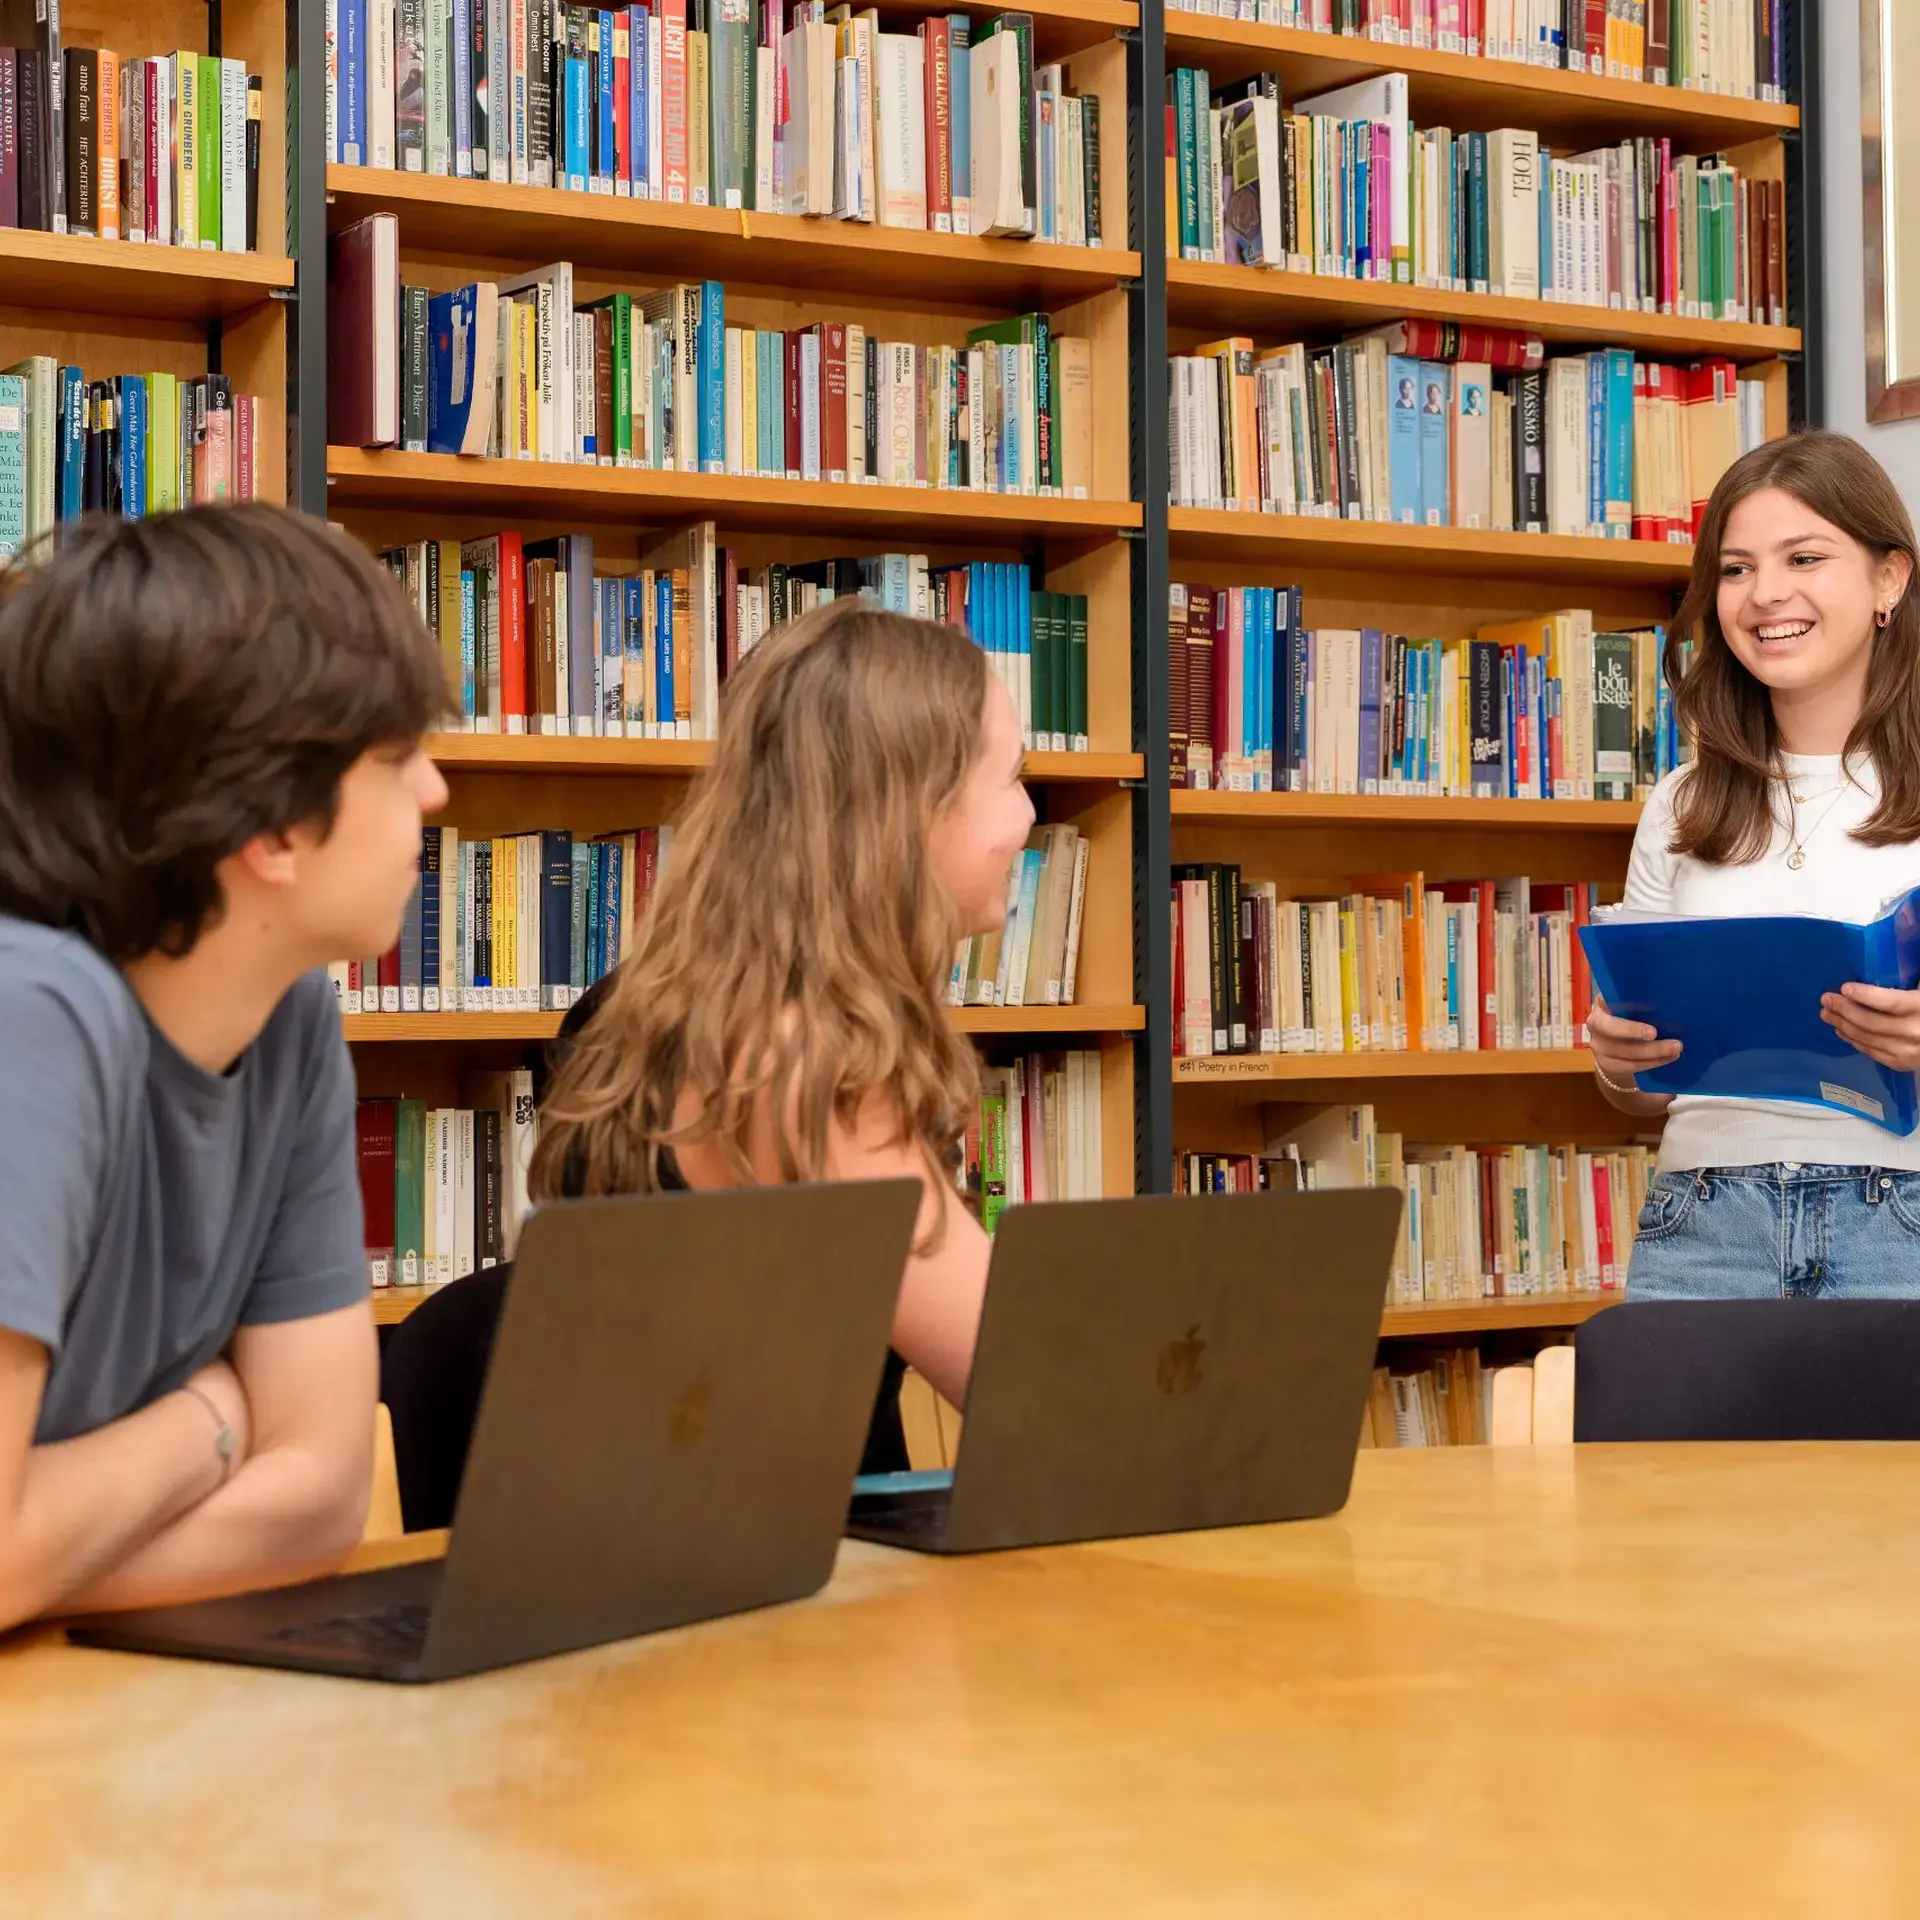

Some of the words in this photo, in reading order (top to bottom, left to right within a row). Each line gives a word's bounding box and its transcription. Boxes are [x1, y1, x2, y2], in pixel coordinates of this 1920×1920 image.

[531, 11, 540, 52] Omnibest
[601, 18, 610, 33] Op
[603, 35, 611, 47] de
[634, 18, 644, 45] J.M.A.
[665, 14, 684, 62] LICHT
[434, 44, 442, 68] Alles
[494, 36, 504, 72] TERUG
[516, 18, 524, 71] WOLKERS
[542, 38, 550, 73] Kooten
[935, 34, 946, 60] C.M.
[80, 65, 88, 92] anne
[102, 62, 114, 96] ESTHER
[434, 70, 442, 80] in
[636, 46, 645, 92] Biesheuvel
[132, 70, 142, 102] Ronald
[184, 68, 192, 106] ARNON
[224, 69, 232, 112] HEREN
[236, 72, 244, 112] HELLA
[434, 80, 443, 97] het
[494, 73, 504, 102] NAAR
[516, 76, 524, 107] KORT
[602, 84, 611, 95] af
[936, 61, 948, 127] BELLMAN
[1182, 76, 1192, 104] JOHAN
[1198, 80, 1208, 112] JOHAN
[80, 94, 90, 122] frank
[102, 98, 114, 146] GERRITSEN
[130, 105, 142, 142] Giphart
[666, 64, 684, 166] LETTERLAND
[224, 114, 232, 138] VAN
[1184, 106, 1194, 142] BORGEN
[1199, 115, 1208, 146] BORGEN
[80, 136, 88, 156] HET
[184, 111, 192, 171] GRUNBERG
[224, 141, 232, 157] DE
[236, 122, 244, 172] HAASSE
[102, 157, 116, 212] DORST
[224, 158, 232, 193] THEE
[667, 170, 685, 183] 4
[1512, 141, 1532, 198] HOEL
[80, 158, 88, 220] ACHTERHUIS
[414, 290, 425, 320] Harry
[541, 288, 551, 336] Perspektiv
[712, 293, 722, 315] Sun
[414, 324, 425, 376] Martinson
[542, 336, 551, 348] på
[712, 318, 722, 370] Axelsson
[1037, 324, 1048, 354] Sven
[542, 350, 552, 381] Fröken
[73, 380, 82, 406] Tessa
[543, 382, 552, 404] Julie
[1038, 356, 1048, 408] Delblanc
[73, 407, 81, 419] de
[128, 390, 137, 414] Geert
[216, 391, 226, 435] Geerten
[413, 384, 424, 417] Dikter
[1524, 373, 1539, 443] WASSMO
[129, 414, 138, 432] Mak
[1008, 417, 1018, 457] Samuels
[1040, 413, 1052, 460] Åminne
[894, 424, 910, 460] ORM
[772, 573, 782, 594] Lars
[894, 562, 903, 578] PC
[750, 595, 758, 611] Jan
[918, 584, 926, 596] PC
[1480, 648, 1490, 688] KIRSTEN
[1597, 672, 1629, 692] bon
[1608, 658, 1622, 676] le
[1480, 690, 1490, 734] THORUP
[1592, 690, 1632, 709] usage
[1198, 1062, 1226, 1074] Poetry
[1229, 1062, 1236, 1072] in
[1240, 1062, 1269, 1072] French
[516, 1095, 533, 1112] 19
